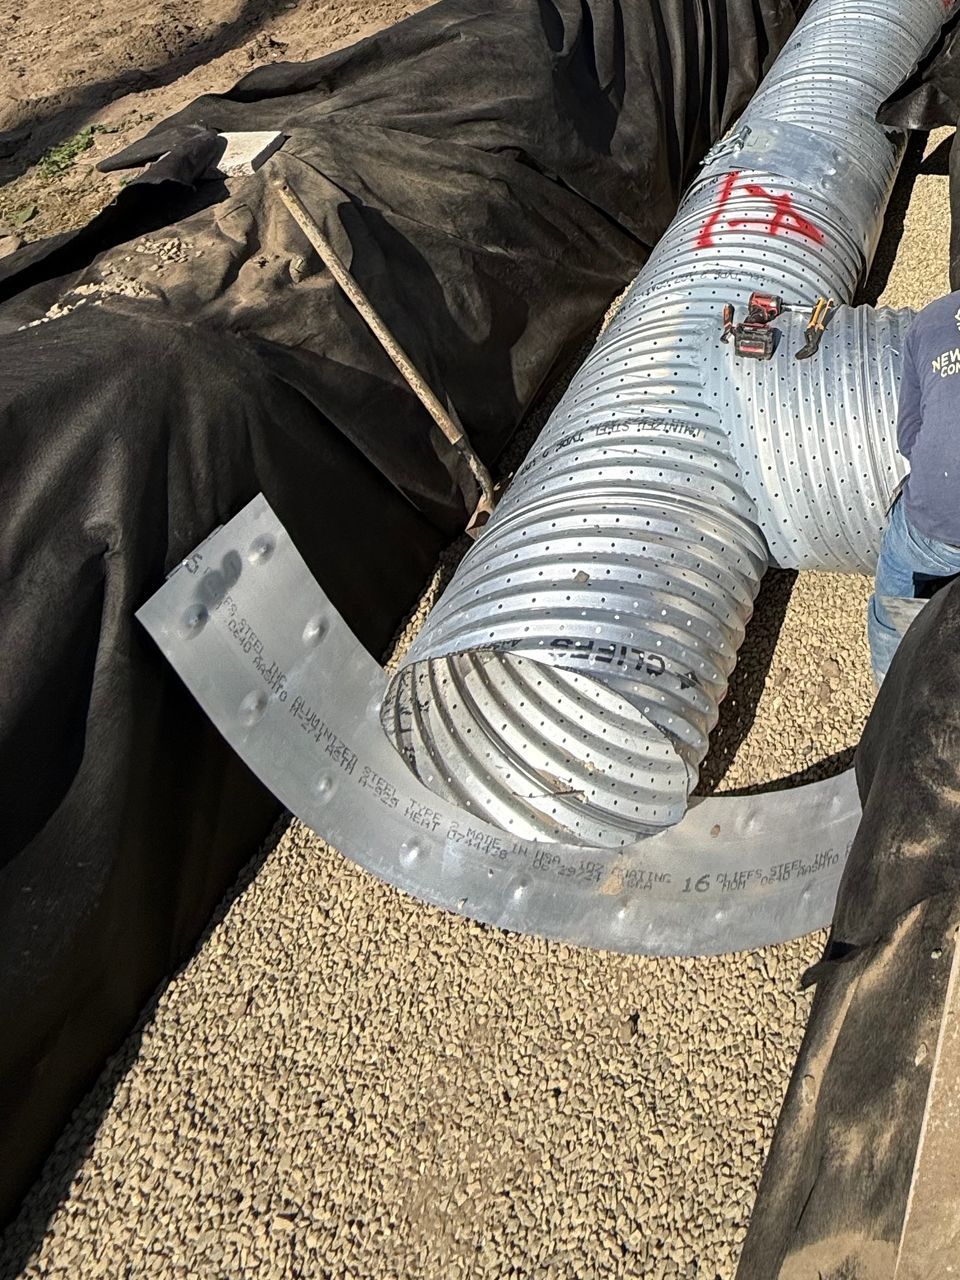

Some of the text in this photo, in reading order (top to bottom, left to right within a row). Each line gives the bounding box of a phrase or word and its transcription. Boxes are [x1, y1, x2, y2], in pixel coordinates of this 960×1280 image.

[409, 797, 443, 821] TYPE
[681, 873, 711, 893] 16
[768, 858, 804, 878] STEEL
